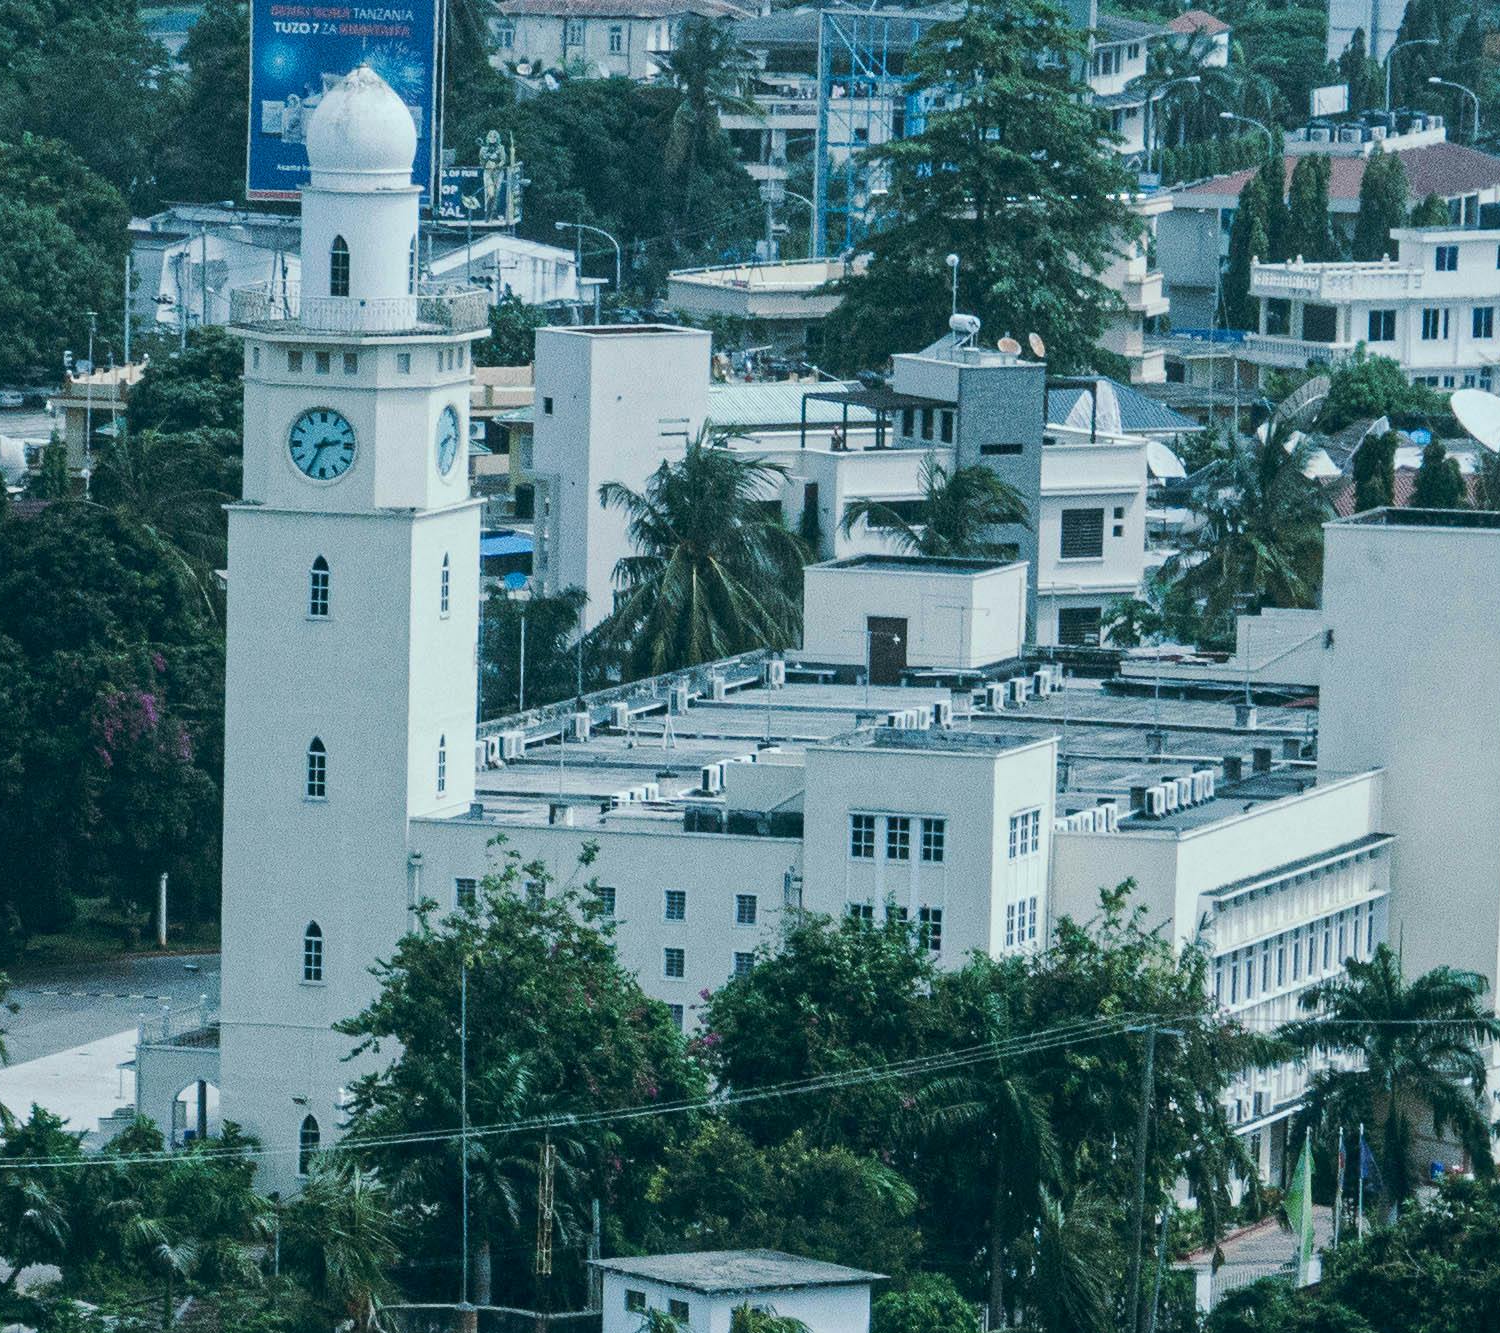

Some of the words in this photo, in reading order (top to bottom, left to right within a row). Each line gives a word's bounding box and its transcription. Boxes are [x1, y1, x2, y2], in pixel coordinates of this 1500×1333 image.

[353, 7, 414, 22] TANZANIA
[273, 21, 311, 34] TUZO
[312, 23, 320, 34] 7
[321, 24, 338, 35] ZA
